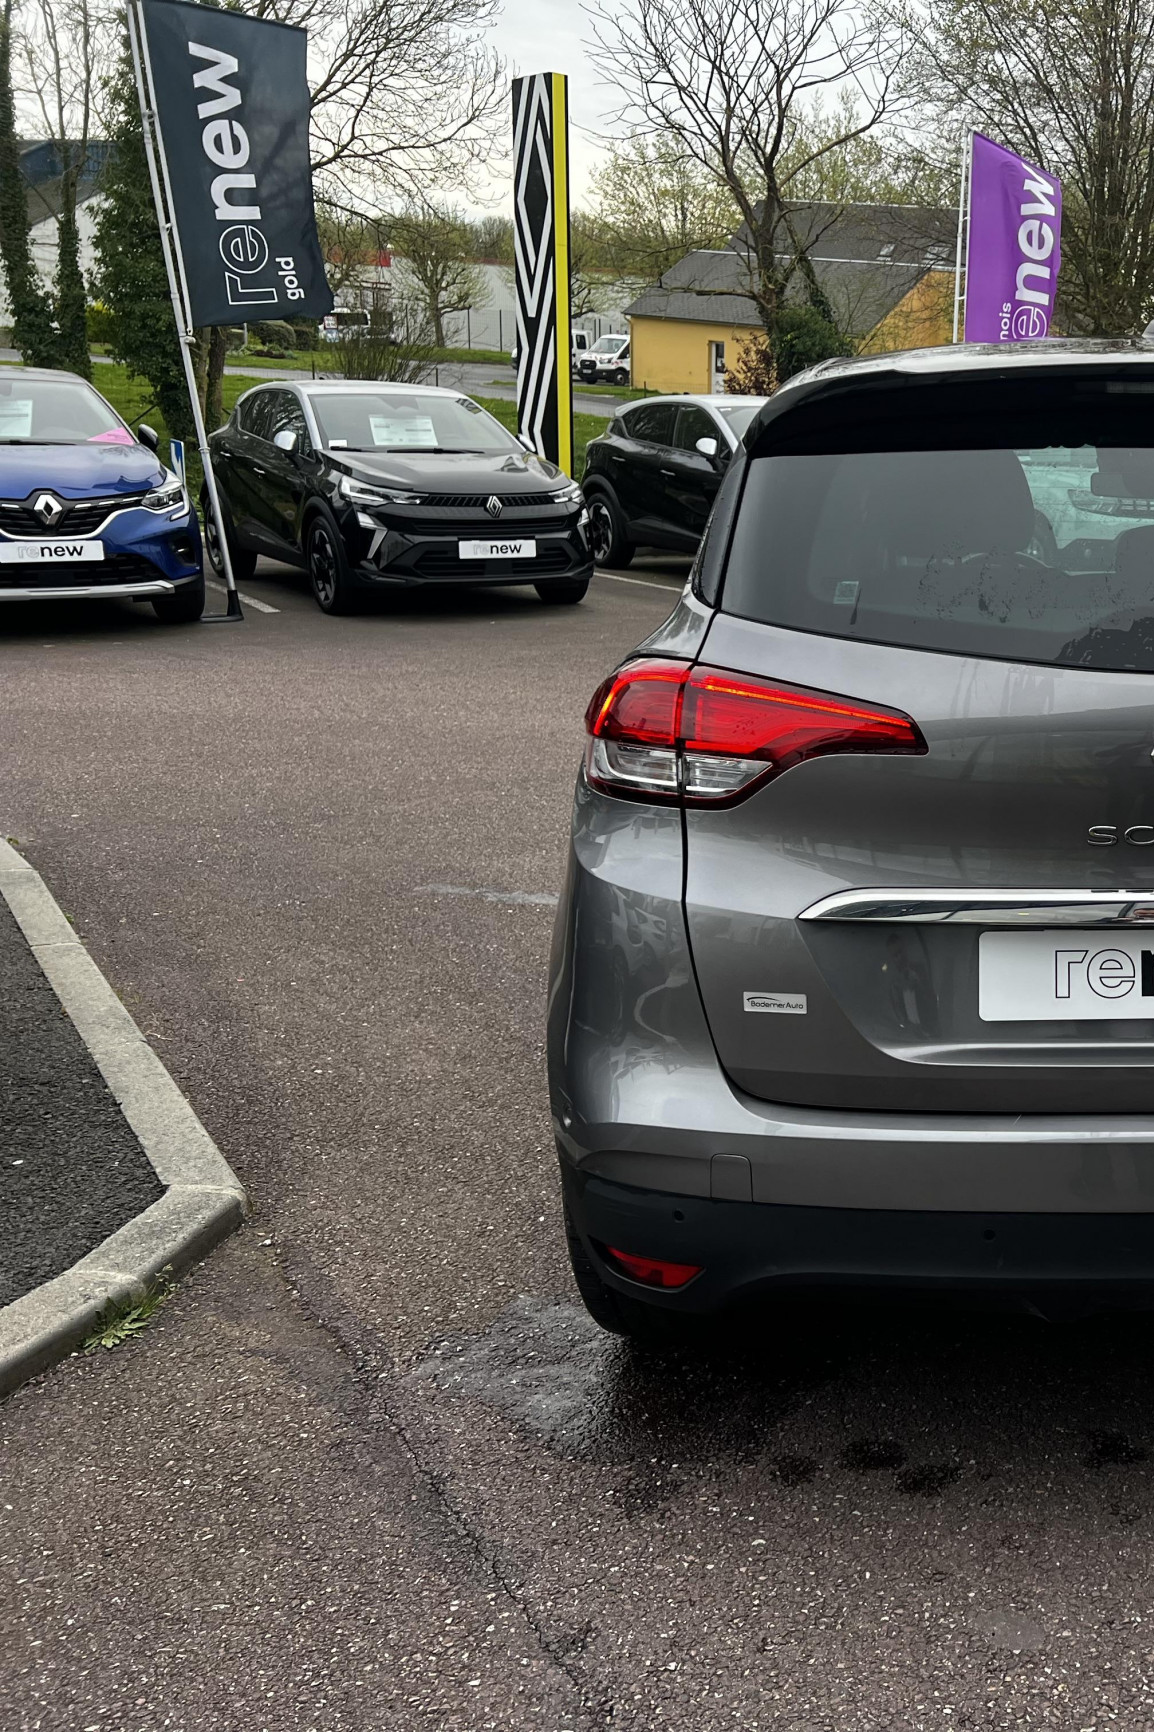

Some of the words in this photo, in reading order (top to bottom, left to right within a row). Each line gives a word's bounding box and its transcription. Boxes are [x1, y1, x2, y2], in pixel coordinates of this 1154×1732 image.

[188, 41, 278, 305] renew
[275, 256, 305, 300] gold
[1012, 161, 1056, 340] enew
[17, 545, 84, 559] renew
